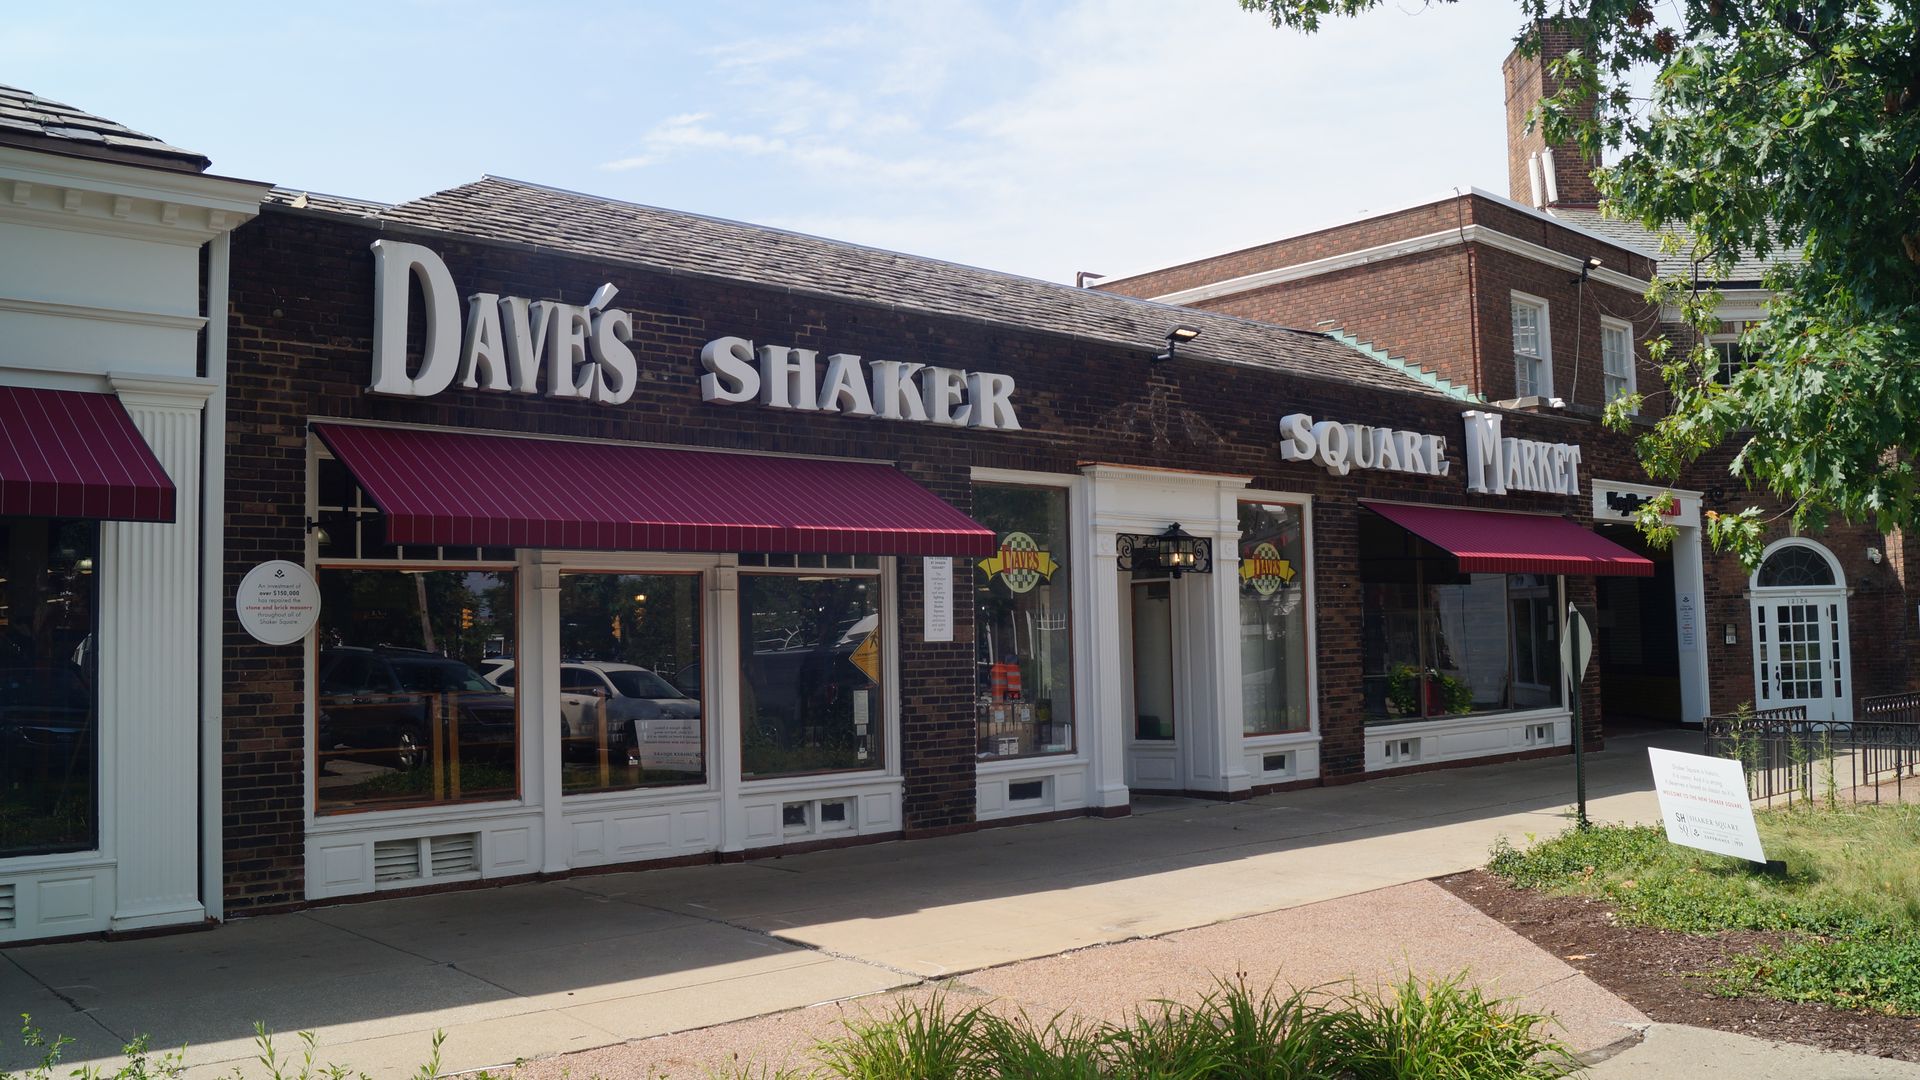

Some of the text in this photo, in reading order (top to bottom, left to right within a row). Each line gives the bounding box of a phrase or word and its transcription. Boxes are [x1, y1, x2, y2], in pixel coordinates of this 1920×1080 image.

[365, 238, 1580, 495] DAVE'S SHAKER SQUARE MARKET
[1675, 812, 1686, 823] SH
[1689, 815, 1739, 831] SHAKER SQUARE
